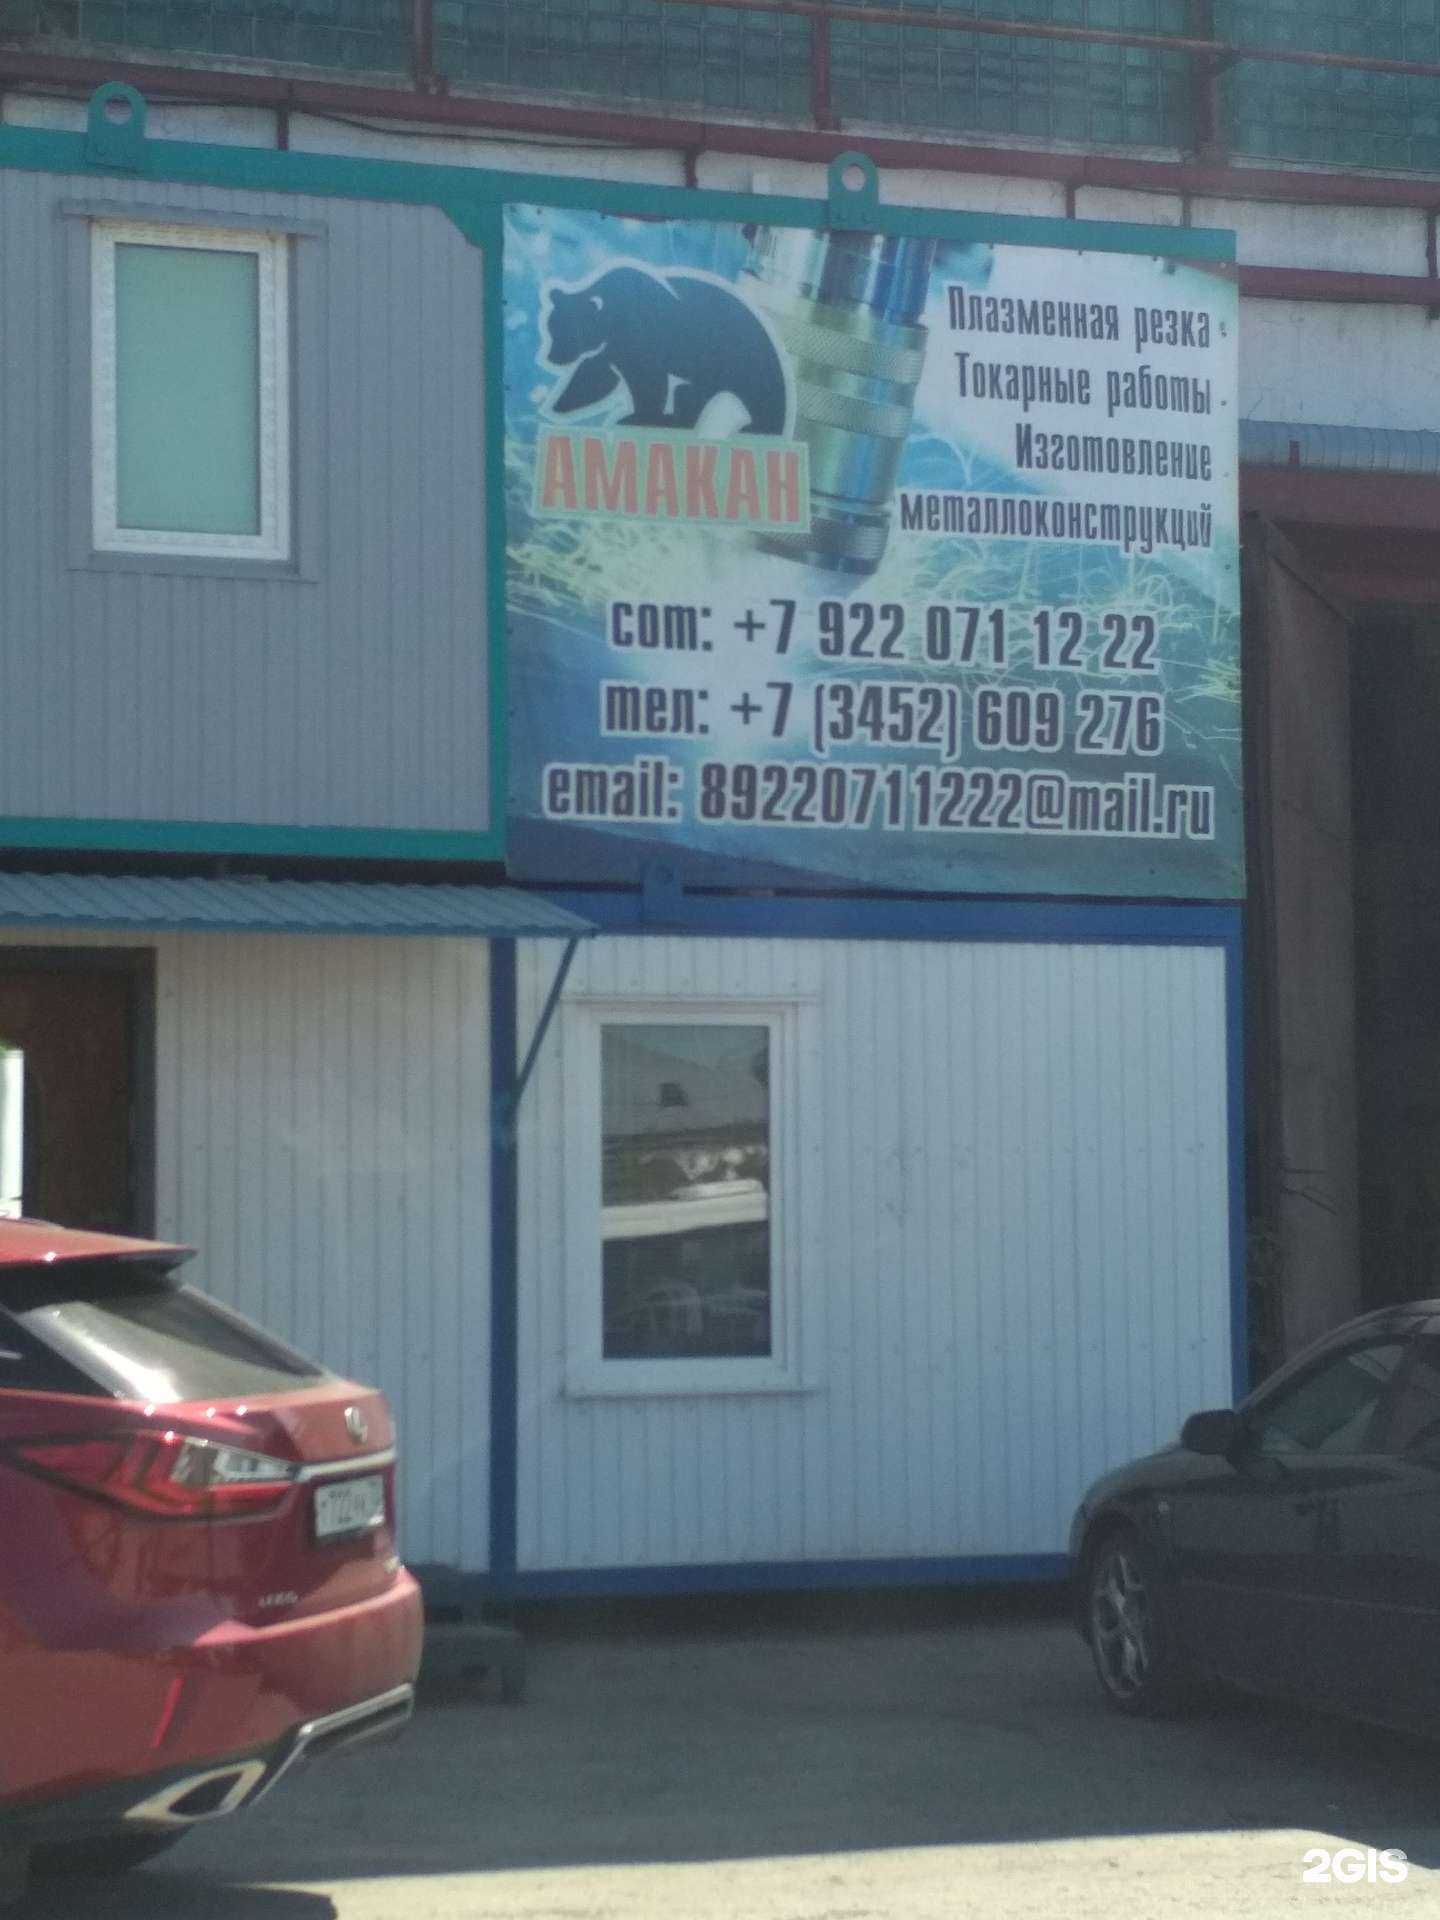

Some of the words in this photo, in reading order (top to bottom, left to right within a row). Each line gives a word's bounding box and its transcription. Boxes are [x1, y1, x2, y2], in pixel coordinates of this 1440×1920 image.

[948, 285, 1120, 342] Плазменная
[1135, 307, 1211, 353] резка
[955, 352, 1091, 410] Токарные
[1107, 364, 1211, 417] работы
[543, 435, 800, 522] АМАКАН
[1015, 423, 1212, 481] Изготовление
[901, 493, 1212, 553] металлоконструкций
[734, 601, 796, 654] +7
[818, 602, 905, 658] 922
[926, 606, 1004, 663] 071
[1034, 611, 1083, 668] 12
[1103, 615, 1156, 671] 22
[730, 682, 792, 737] +7
[814, 683, 959, 757] (3452)
[977, 690, 1060, 750] 609
[1080, 696, 1162, 753] 276
[548, 761, 679, 818] email:
[700, 763, 1211, 835] 89220711222@mail.ru
